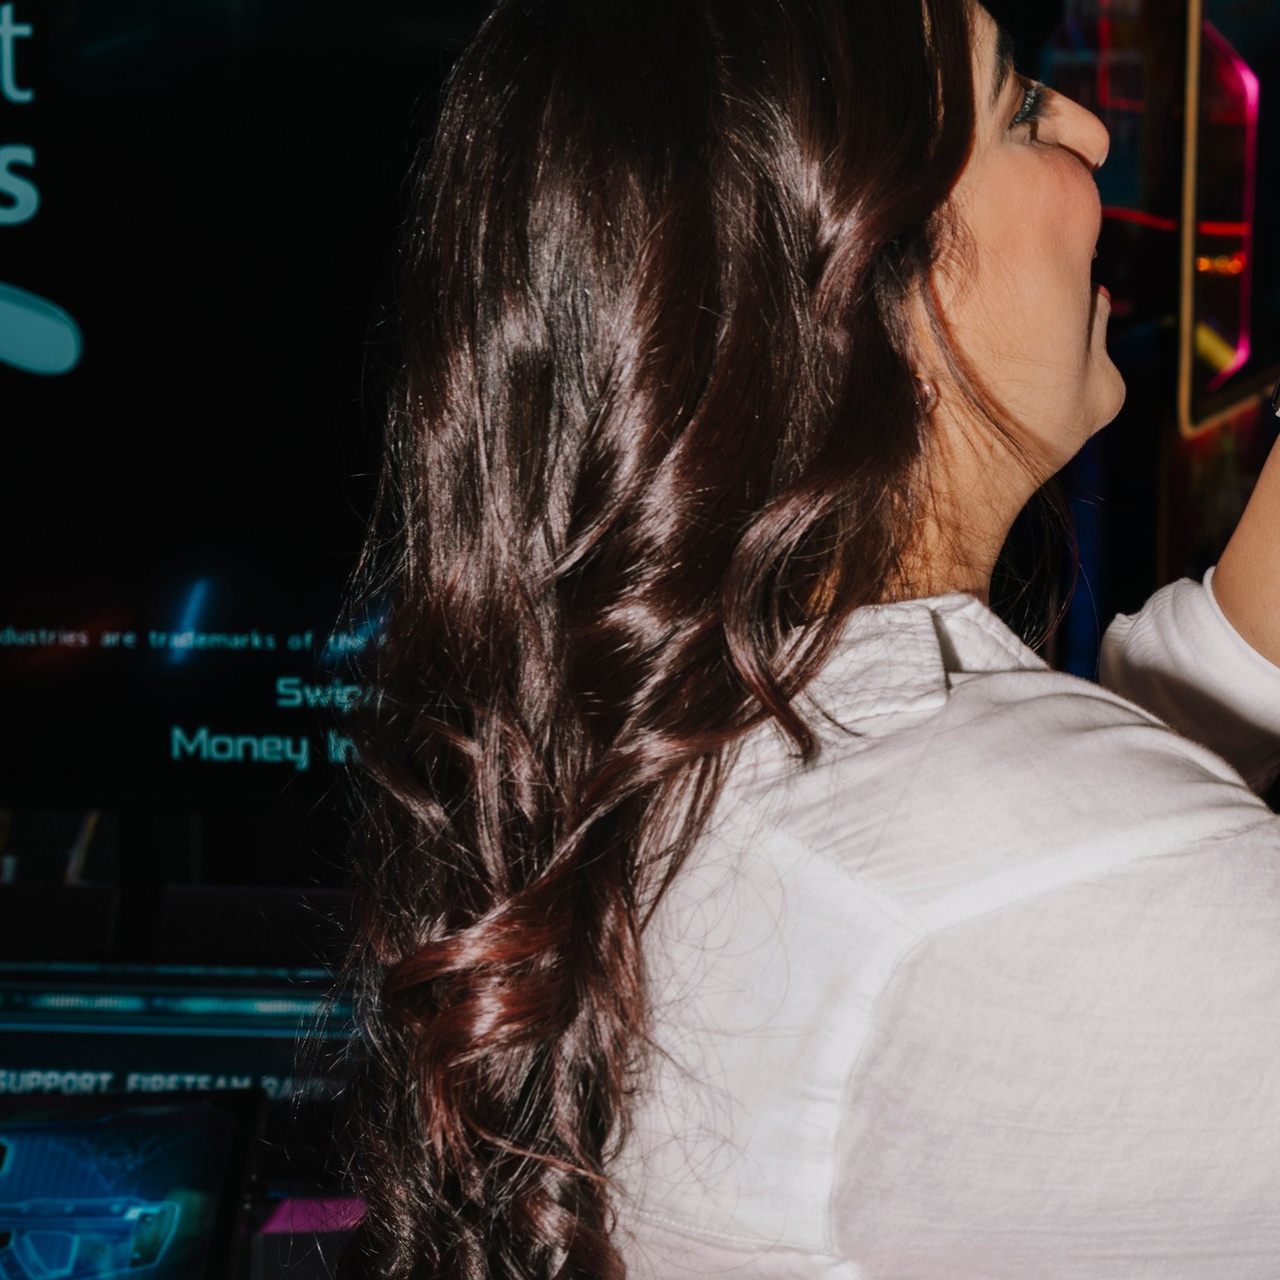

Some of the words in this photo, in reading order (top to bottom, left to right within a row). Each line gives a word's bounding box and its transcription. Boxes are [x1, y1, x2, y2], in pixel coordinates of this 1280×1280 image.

[100, 629, 137, 650] are
[148, 629, 277, 652] trademarks
[287, 630, 313, 652] of
[170, 725, 310, 772] Money
[125, 1072, 253, 1093] FIRETEAM
